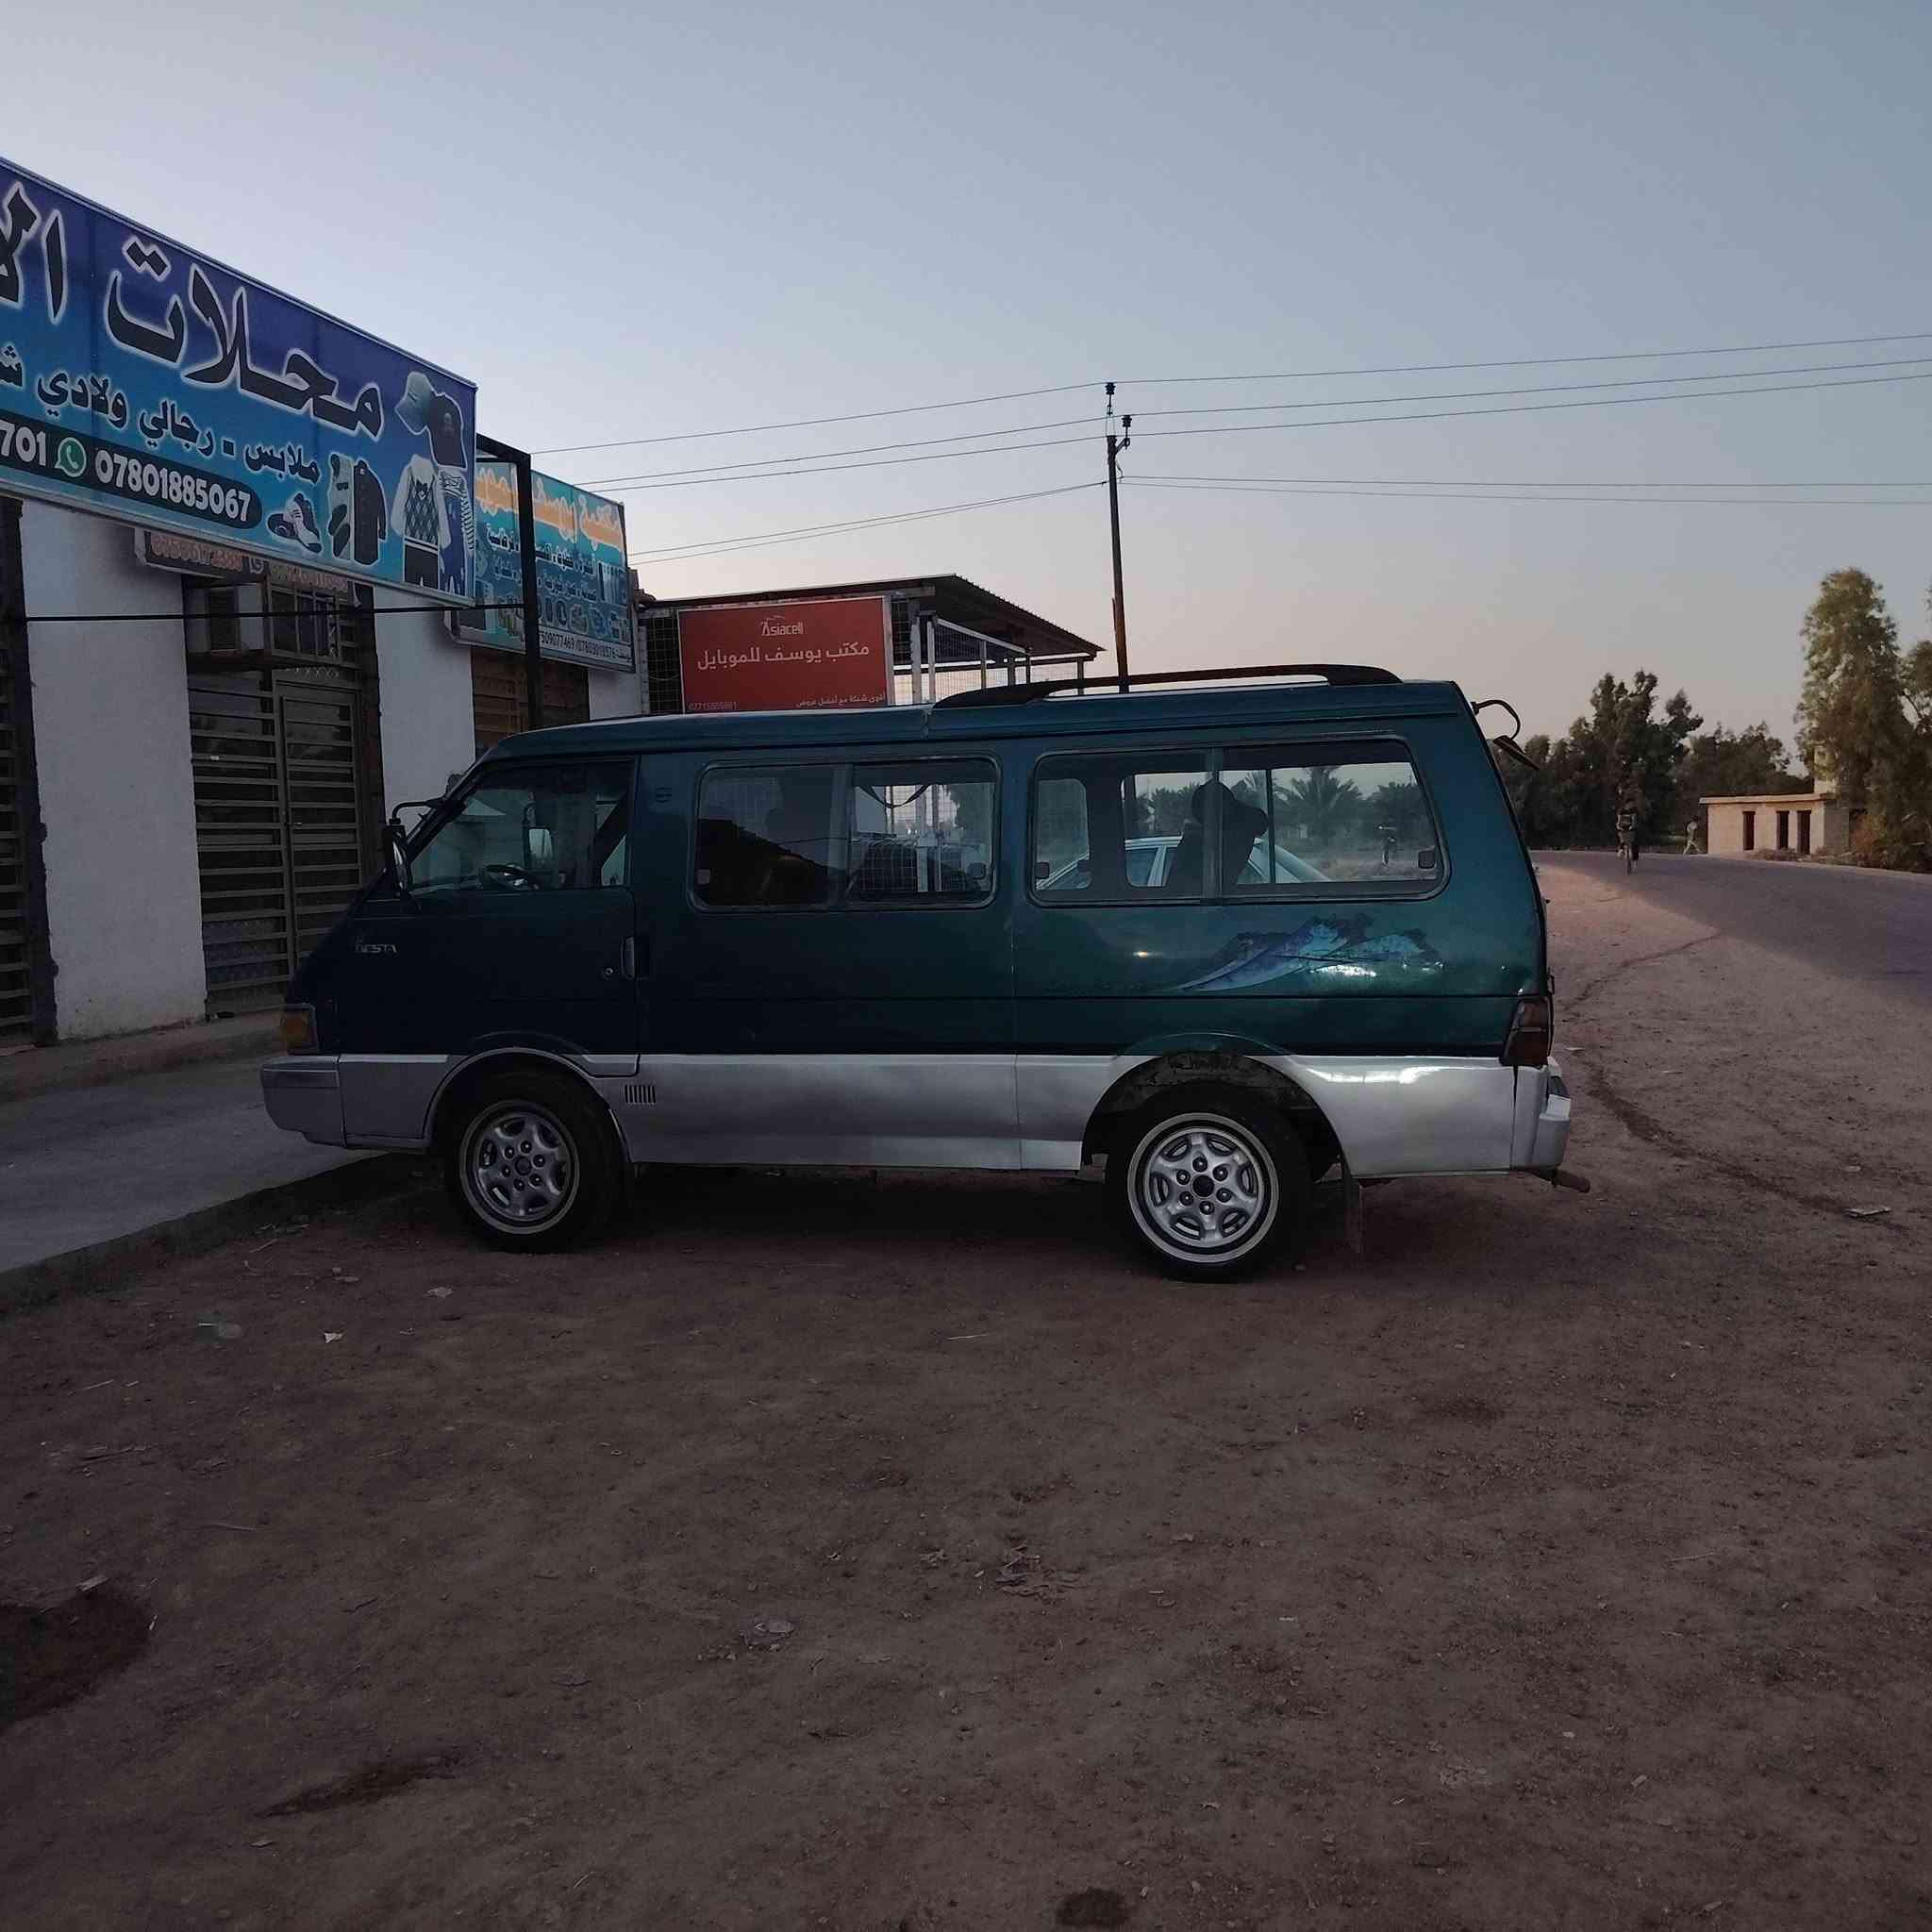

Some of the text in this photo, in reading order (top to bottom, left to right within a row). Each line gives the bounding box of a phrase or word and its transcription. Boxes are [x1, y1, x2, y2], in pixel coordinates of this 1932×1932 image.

[107, 236, 383, 439] محلات
[38, 372, 128, 428] ولادي
[140, 400, 214, 457] رجالي
[95, 449, 251, 521] 07801885067
[244, 443, 321, 484] ملابس
[697, 641, 870, 670] مكتب يوسف للموبايل
[761, 620, 804, 637] Asiacell
